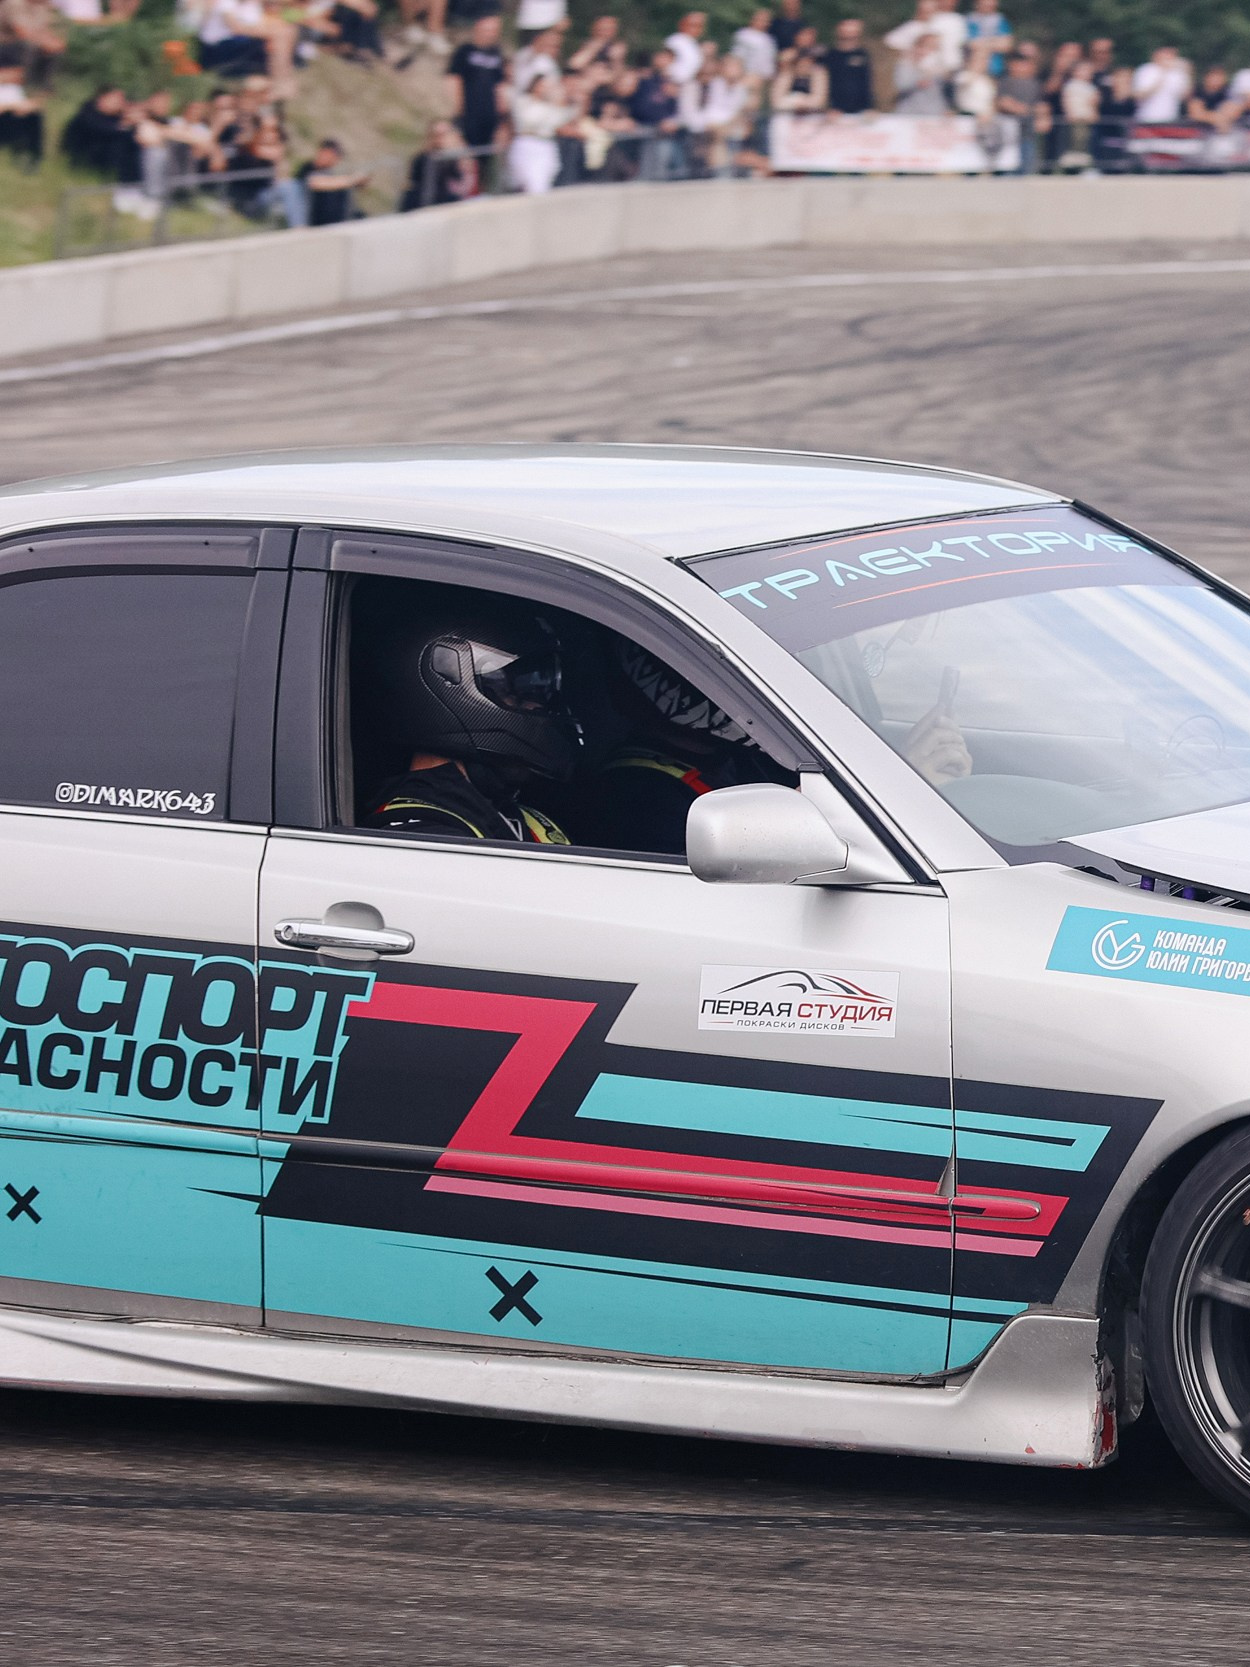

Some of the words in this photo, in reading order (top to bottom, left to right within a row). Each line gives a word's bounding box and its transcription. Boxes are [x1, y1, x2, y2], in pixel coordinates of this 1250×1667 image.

[719, 530, 1153, 610] ТРАЕКТОРИЯ
[1153, 929, 1228, 957] КОМАНДА
[1145, 950, 1191, 974] ЮЛИИ
[700, 999, 793, 1018] ПЕРВАЯ
[797, 1003, 893, 1023] СТУДИЯ
[736, 1019, 796, 1029] ПОКРАСКИ
[799, 1022, 846, 1031] ДИСКОВ
